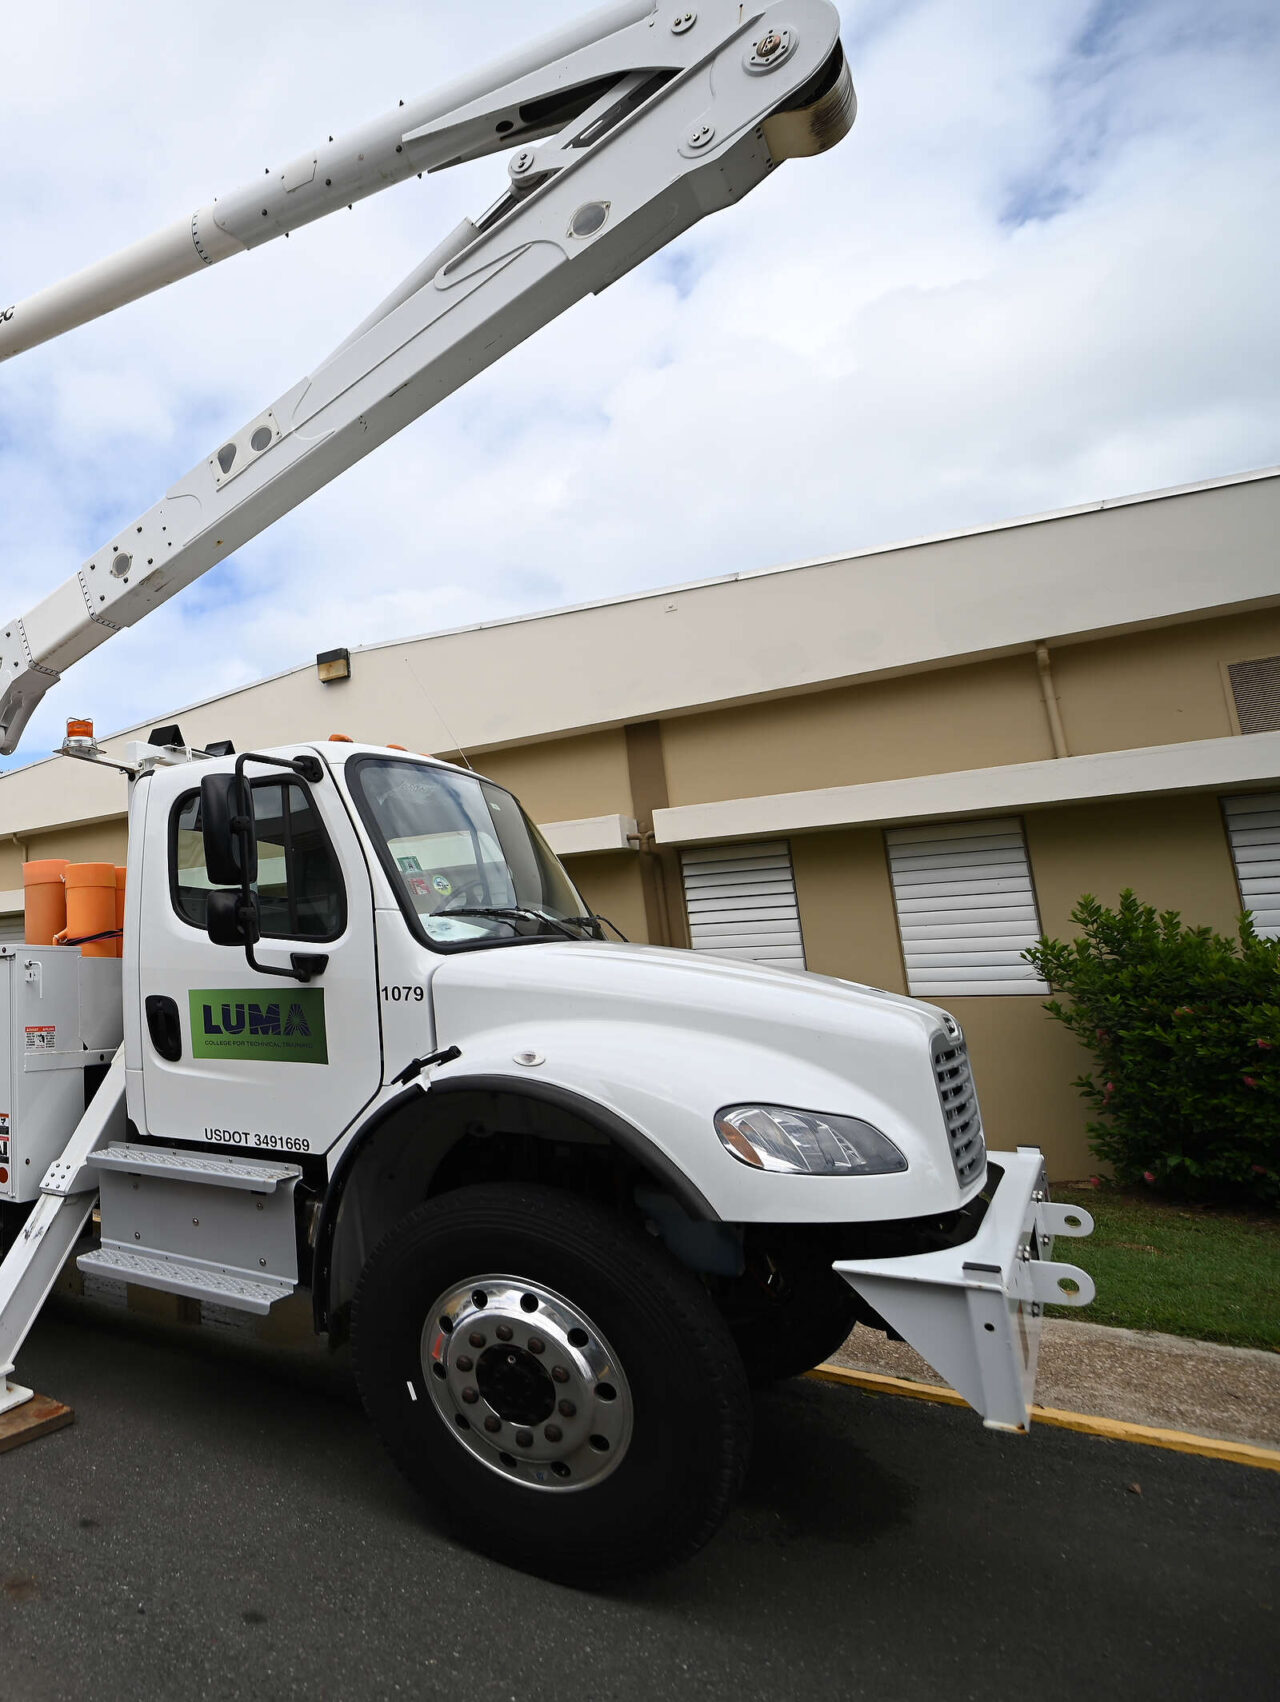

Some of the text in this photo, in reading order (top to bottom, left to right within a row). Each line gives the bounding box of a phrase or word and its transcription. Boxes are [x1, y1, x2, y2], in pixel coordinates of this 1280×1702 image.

[381, 986, 424, 1001] 1079
[203, 1003, 312, 1036] LUMA
[205, 1128, 310, 1151] USDOT 3491669
